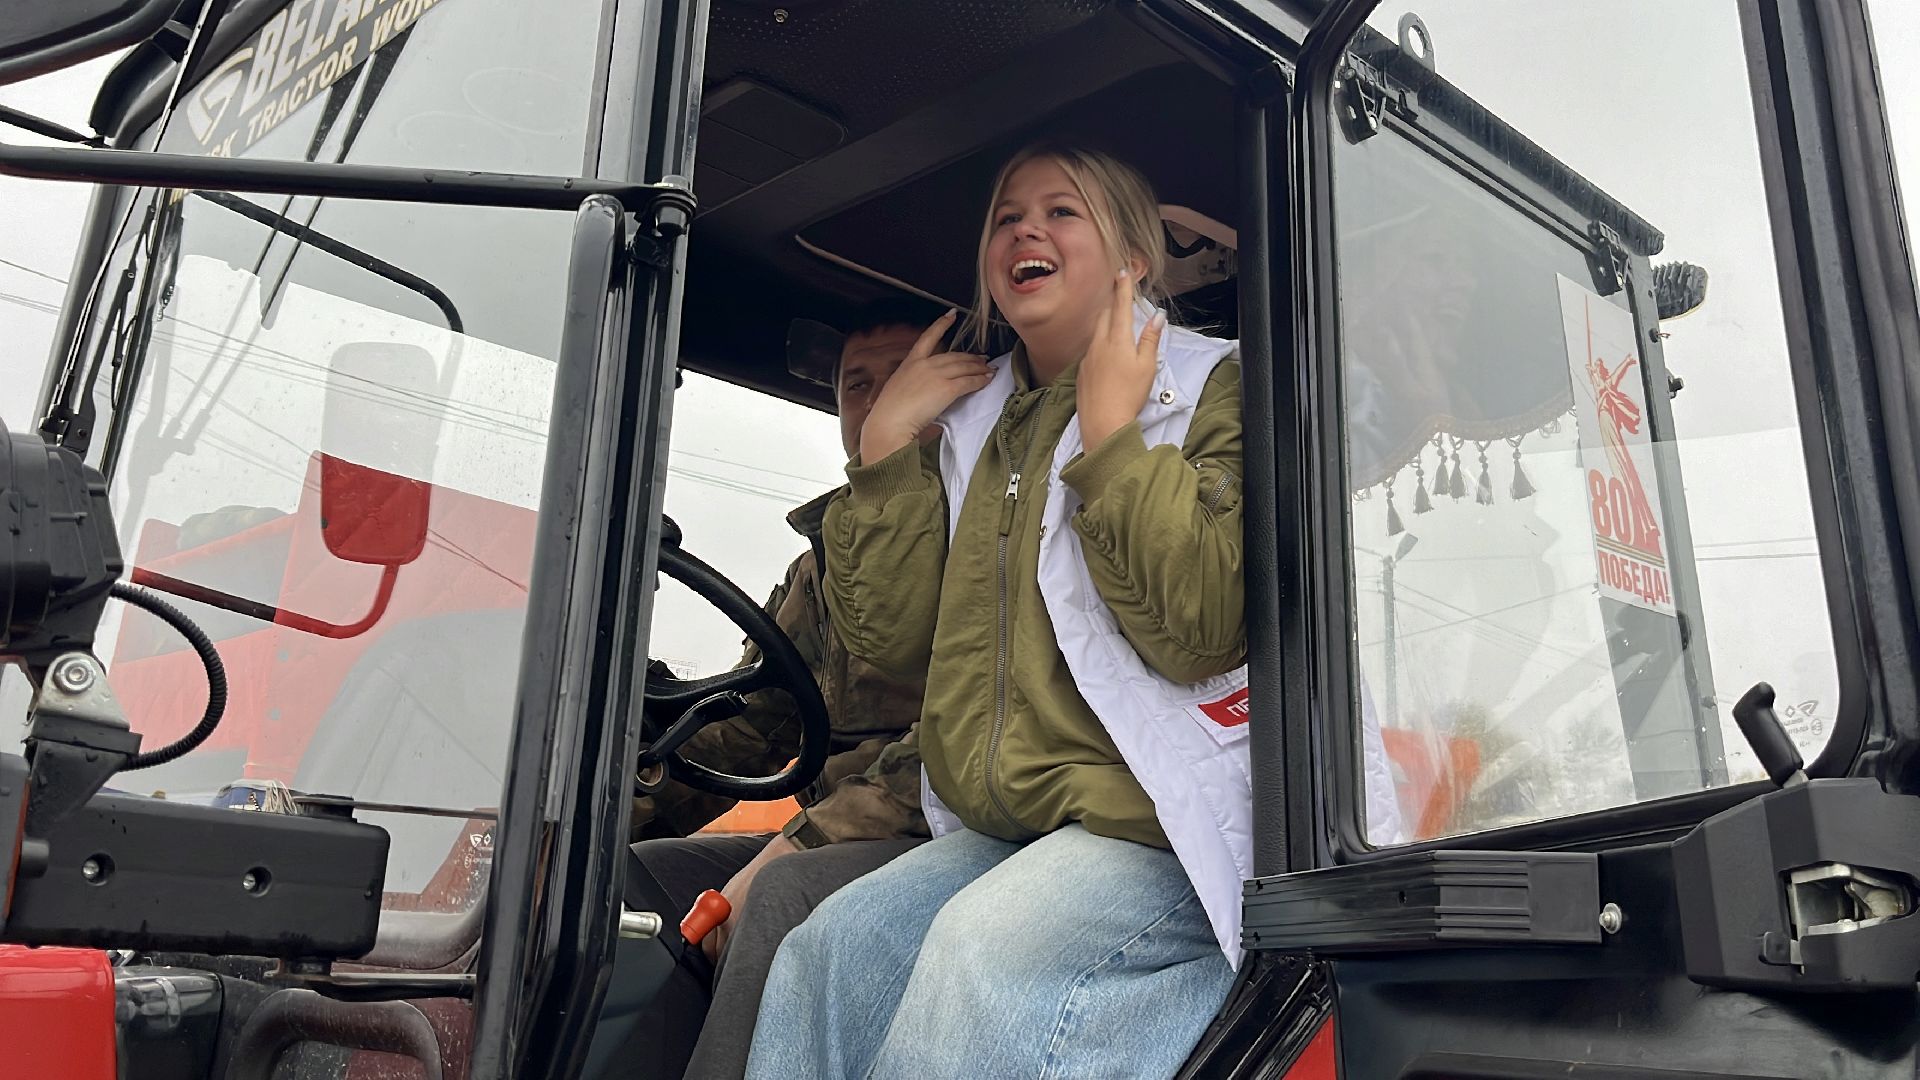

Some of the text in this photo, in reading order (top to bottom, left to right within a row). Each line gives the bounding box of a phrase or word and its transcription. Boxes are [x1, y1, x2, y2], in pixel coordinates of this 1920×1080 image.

[238, 0, 388, 117] BELA
[246, 36, 359, 147] TRACTOR
[1588, 469, 1632, 545] 80
[1598, 549, 1671, 606] ПОБЕДА!
